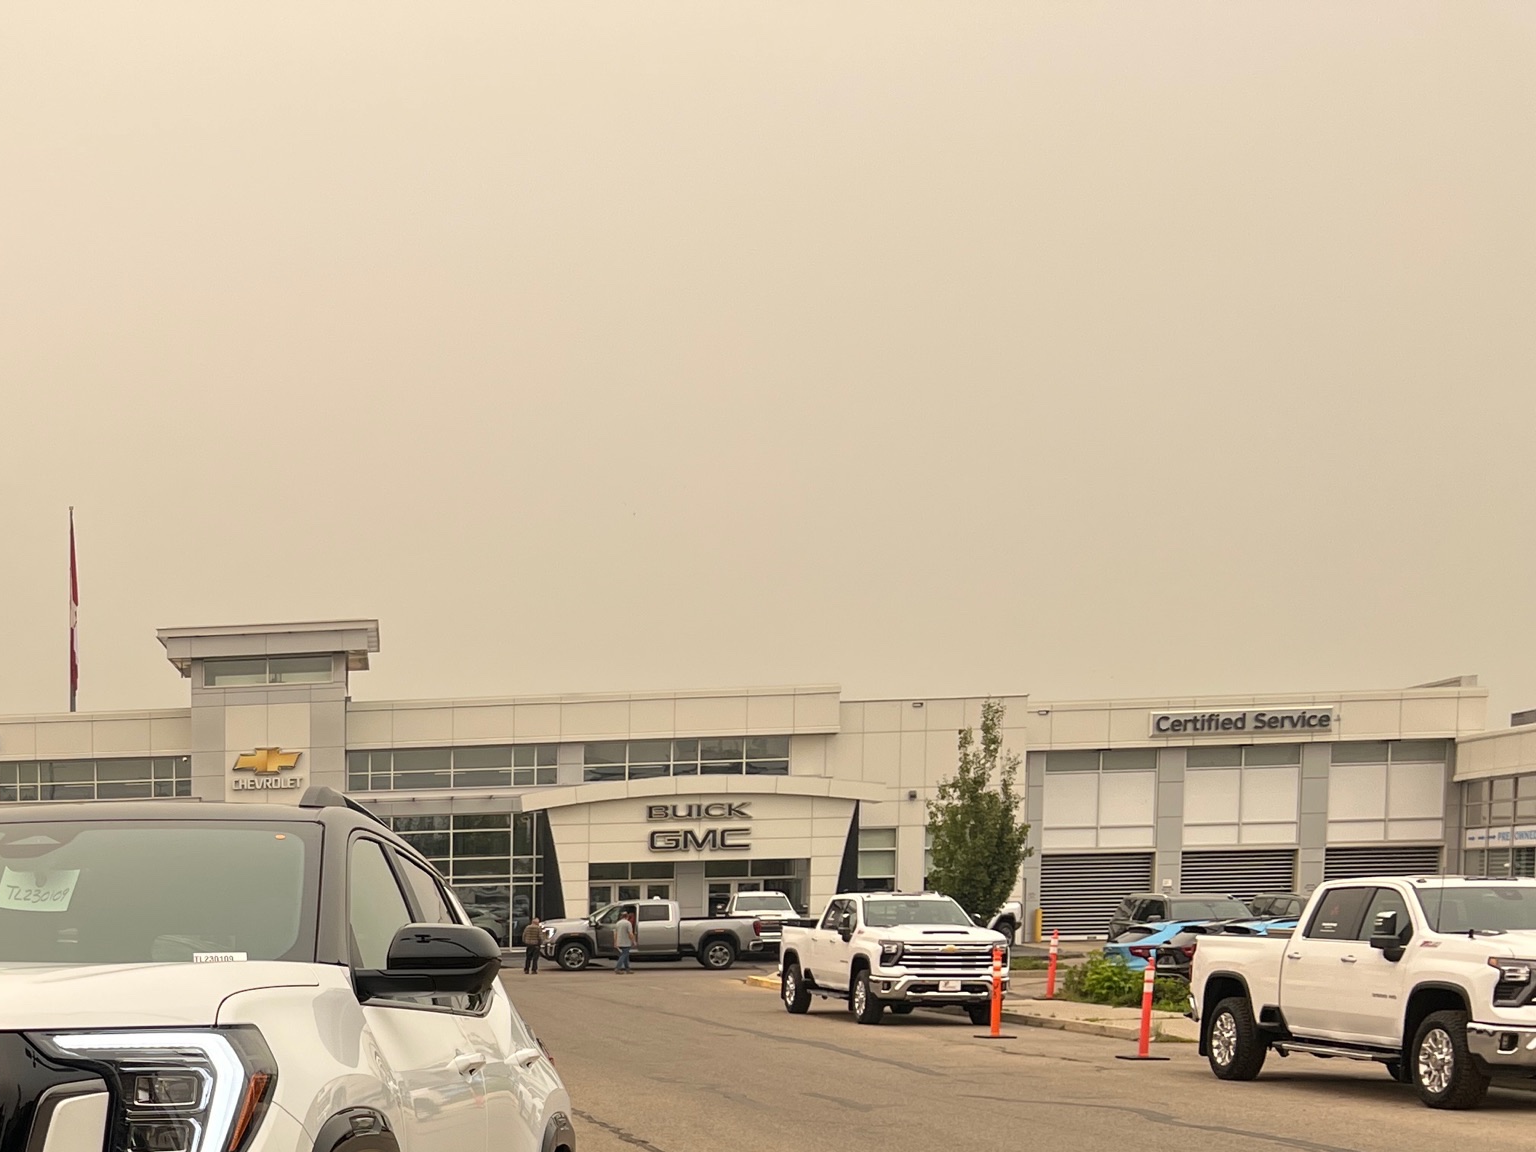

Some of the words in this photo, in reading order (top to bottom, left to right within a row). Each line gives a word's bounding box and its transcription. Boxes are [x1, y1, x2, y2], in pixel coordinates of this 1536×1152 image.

[1156, 712, 1247, 733] Certified
[1253, 711, 1332, 730] Service
[232, 777, 302, 791] CHEVROLET
[646, 802, 752, 821] BUICK
[648, 827, 751, 852] GMC
[7, 884, 70, 904] TL230109
